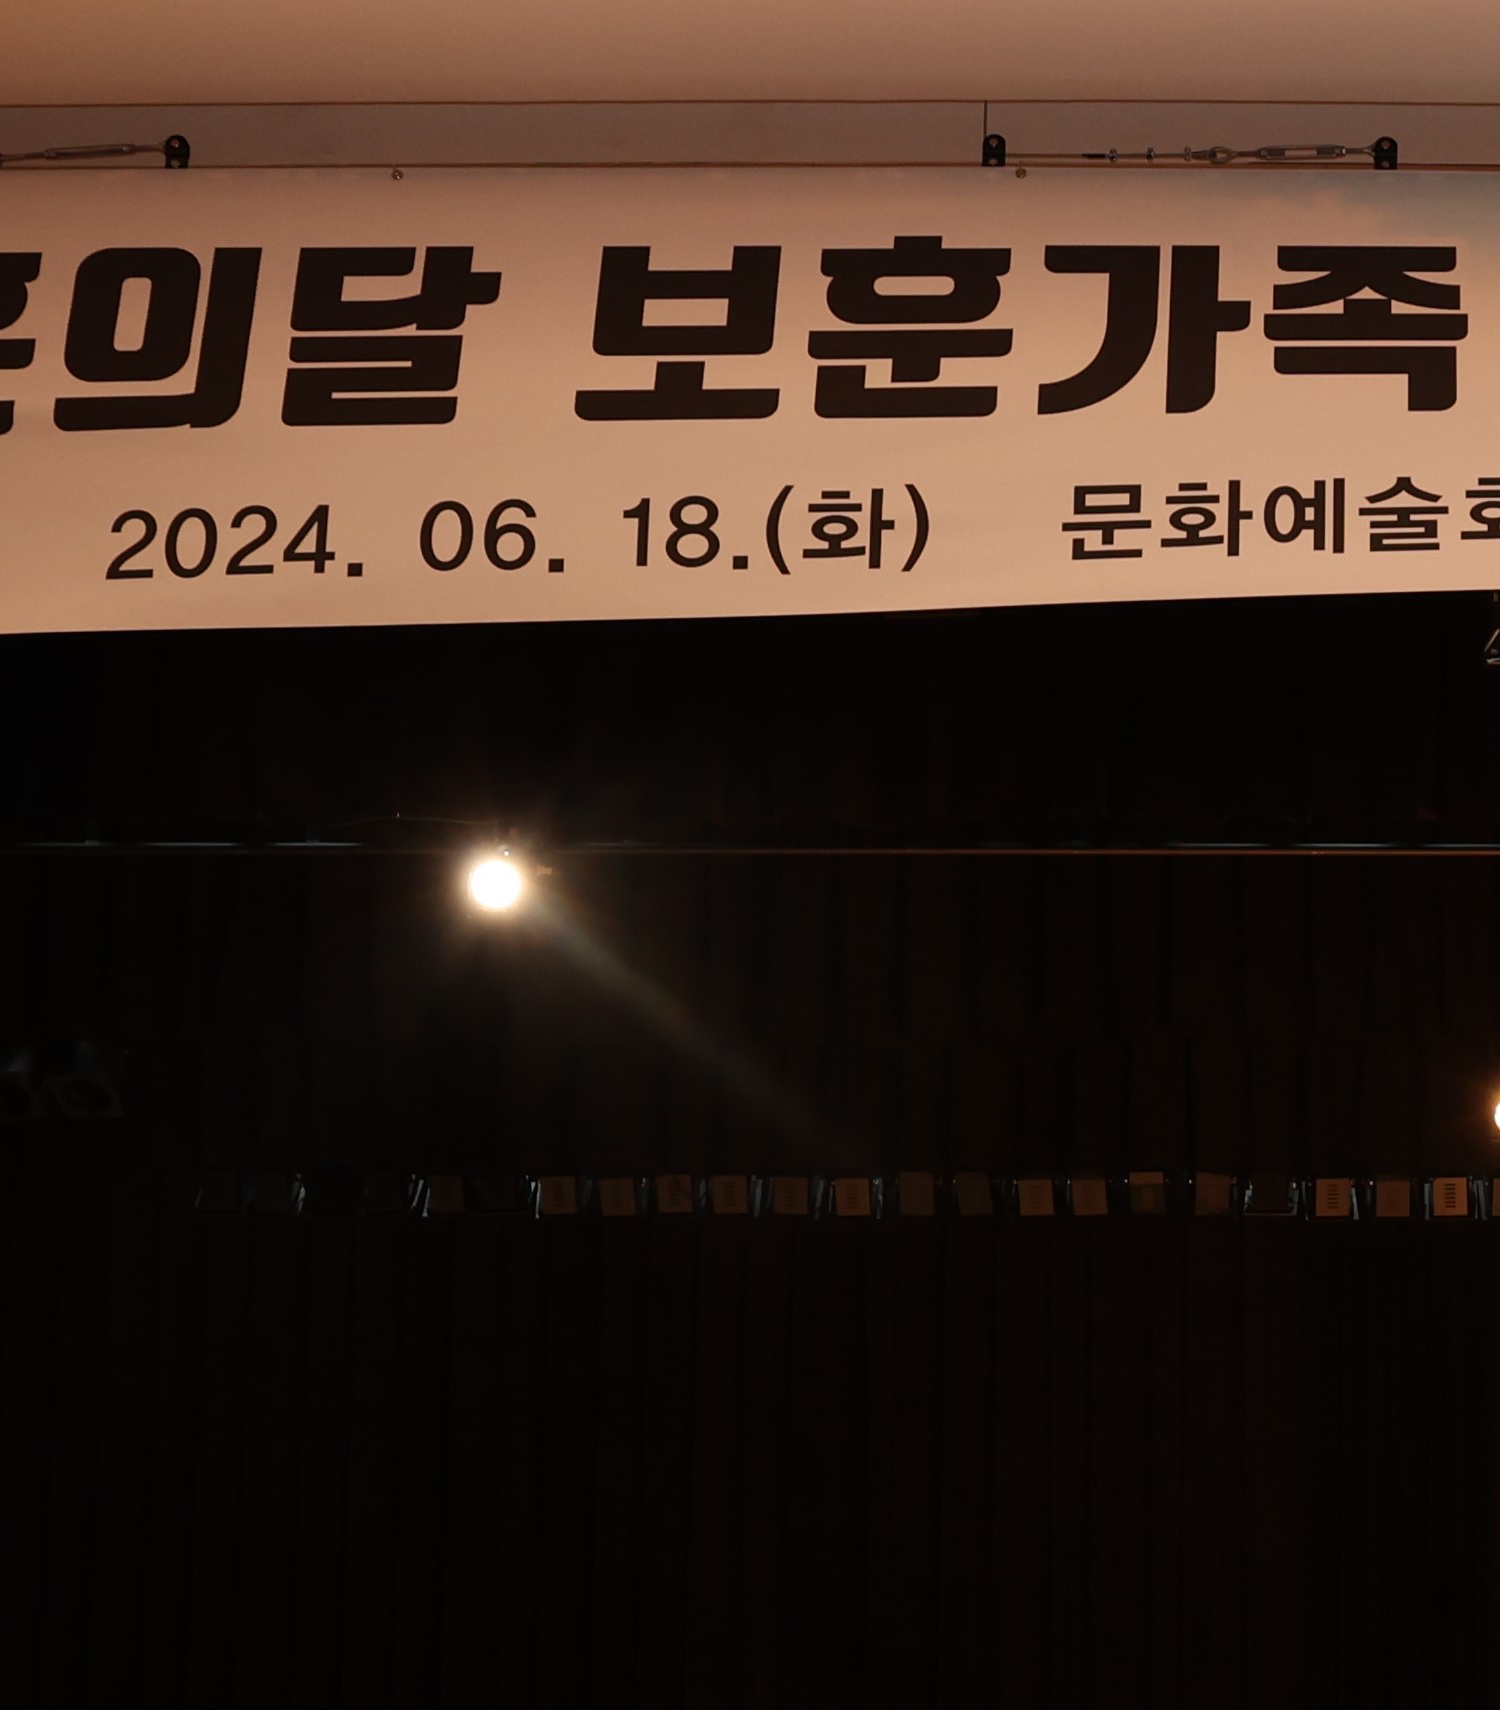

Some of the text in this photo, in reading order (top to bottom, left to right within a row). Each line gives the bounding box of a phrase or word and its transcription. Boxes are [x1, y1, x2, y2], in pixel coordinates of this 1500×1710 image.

[575, 236, 1468, 421] 보훈가족
[105, 483, 930, 580] 2024. 06. 18.(화)
